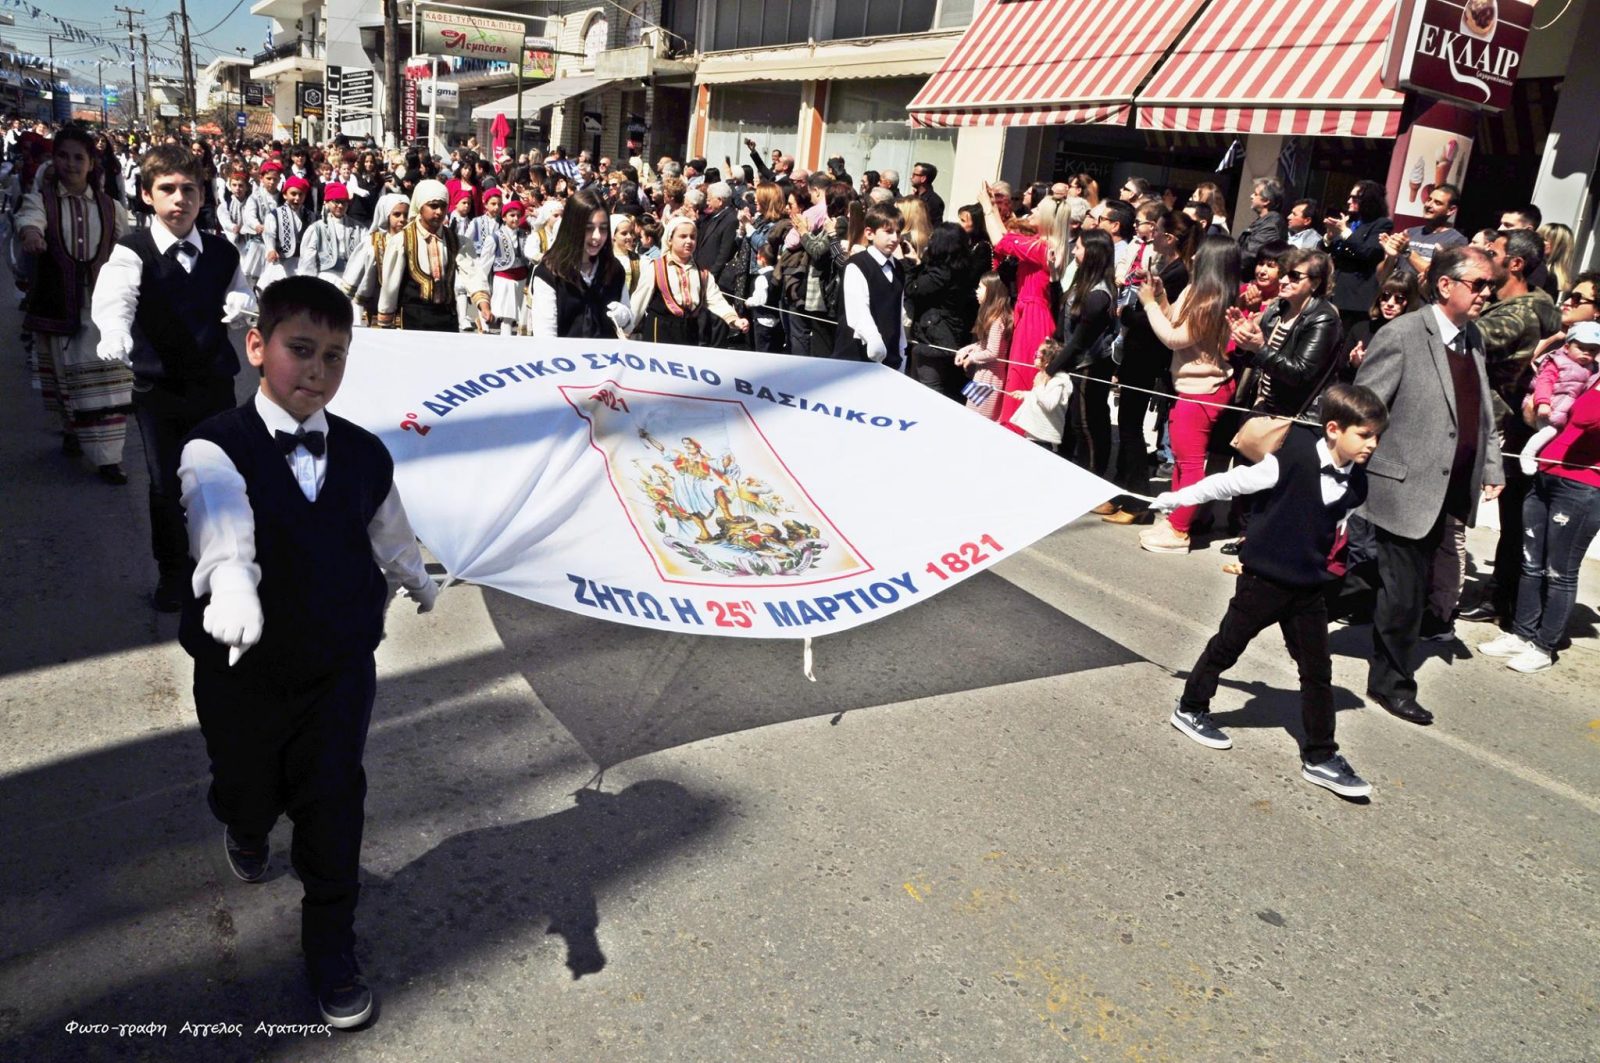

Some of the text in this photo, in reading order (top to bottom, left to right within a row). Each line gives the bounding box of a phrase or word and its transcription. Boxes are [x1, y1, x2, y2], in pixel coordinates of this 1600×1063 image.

[1417, 23, 1520, 80] ΕΚΛΑΙΡ
[427, 86, 457, 96] Sgma
[422, 357, 576, 417] ΔΗΜΟΤΙΚΟ
[582, 352, 722, 386] ΣΧΟΛΕΙΟ
[734, 378, 919, 432] ΒΑΣΙΛΙΚΟΥ
[566, 573, 671, 622] ΖΗΤΩ
[669, 597, 704, 625] Η
[763, 571, 920, 628] ΜΑΡΤΙΟΥ
[925, 533, 1004, 581] 1821
